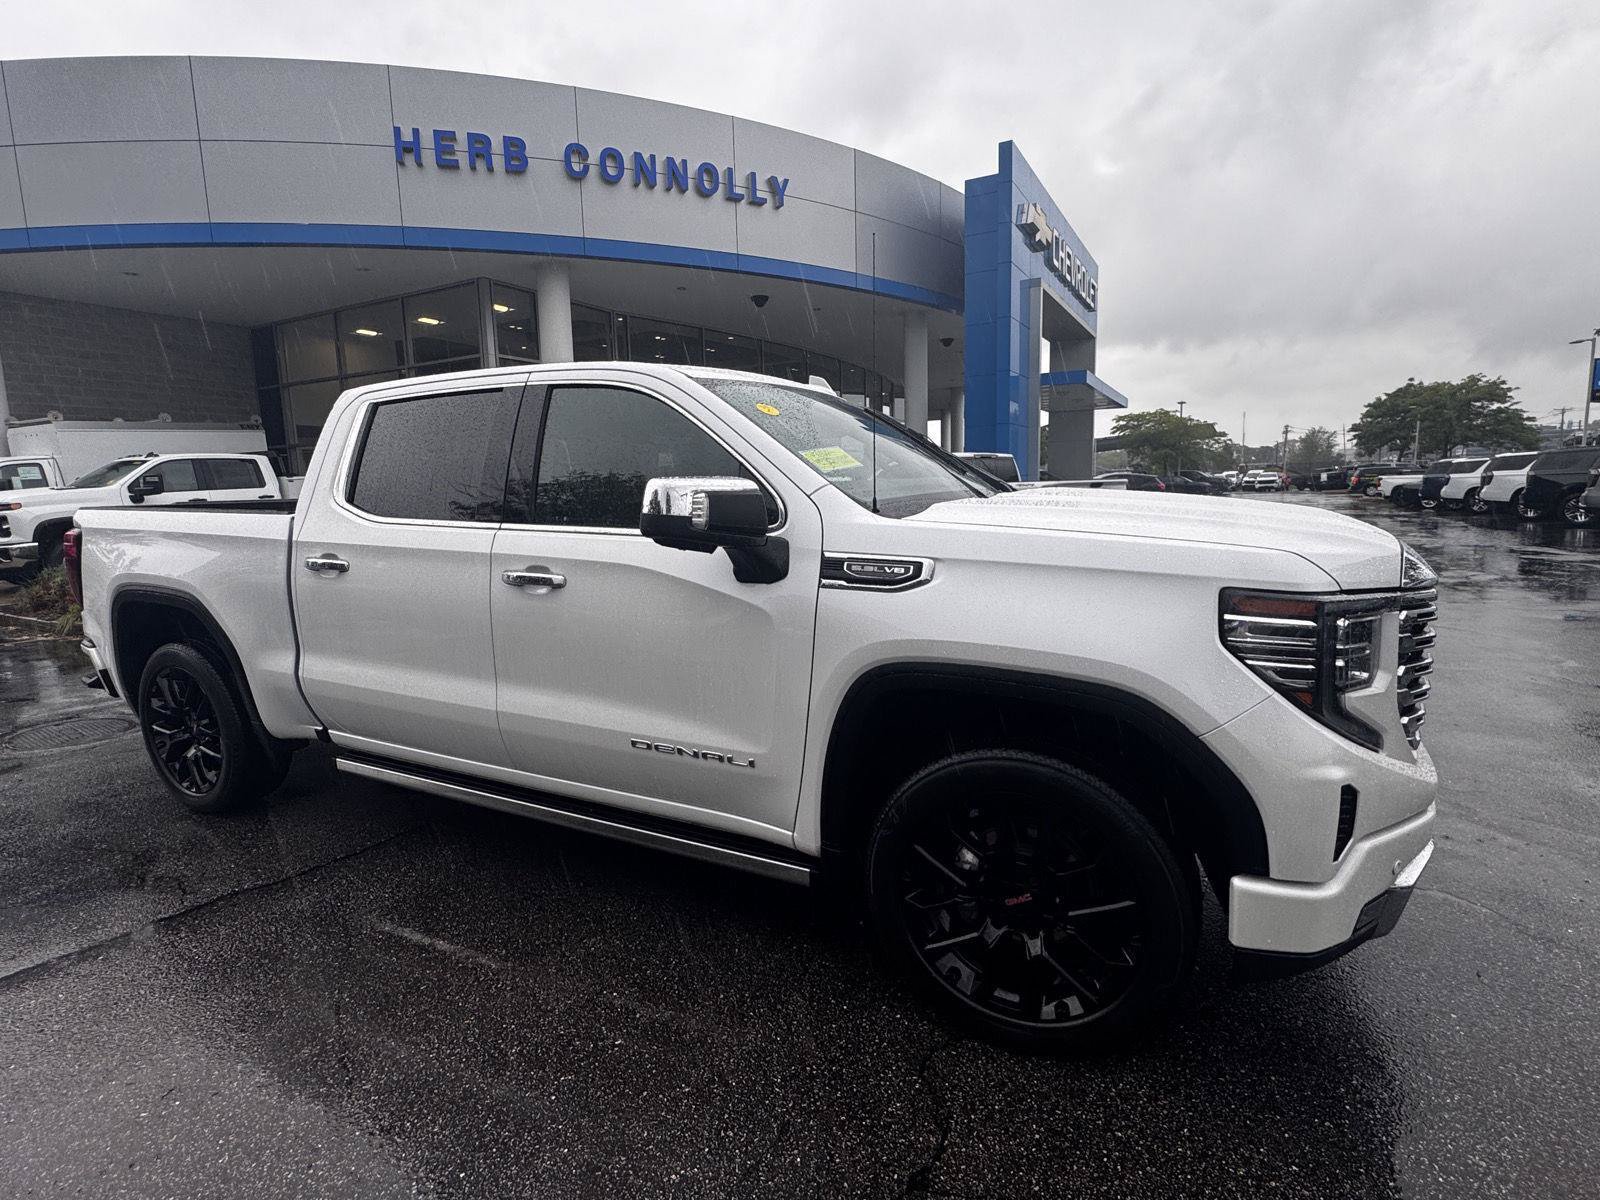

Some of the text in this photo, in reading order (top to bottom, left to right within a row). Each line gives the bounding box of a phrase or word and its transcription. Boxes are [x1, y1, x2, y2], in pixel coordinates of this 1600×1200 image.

[394, 126, 789, 208] HERB CONNOLLY
[630, 738, 755, 768] DENALI
